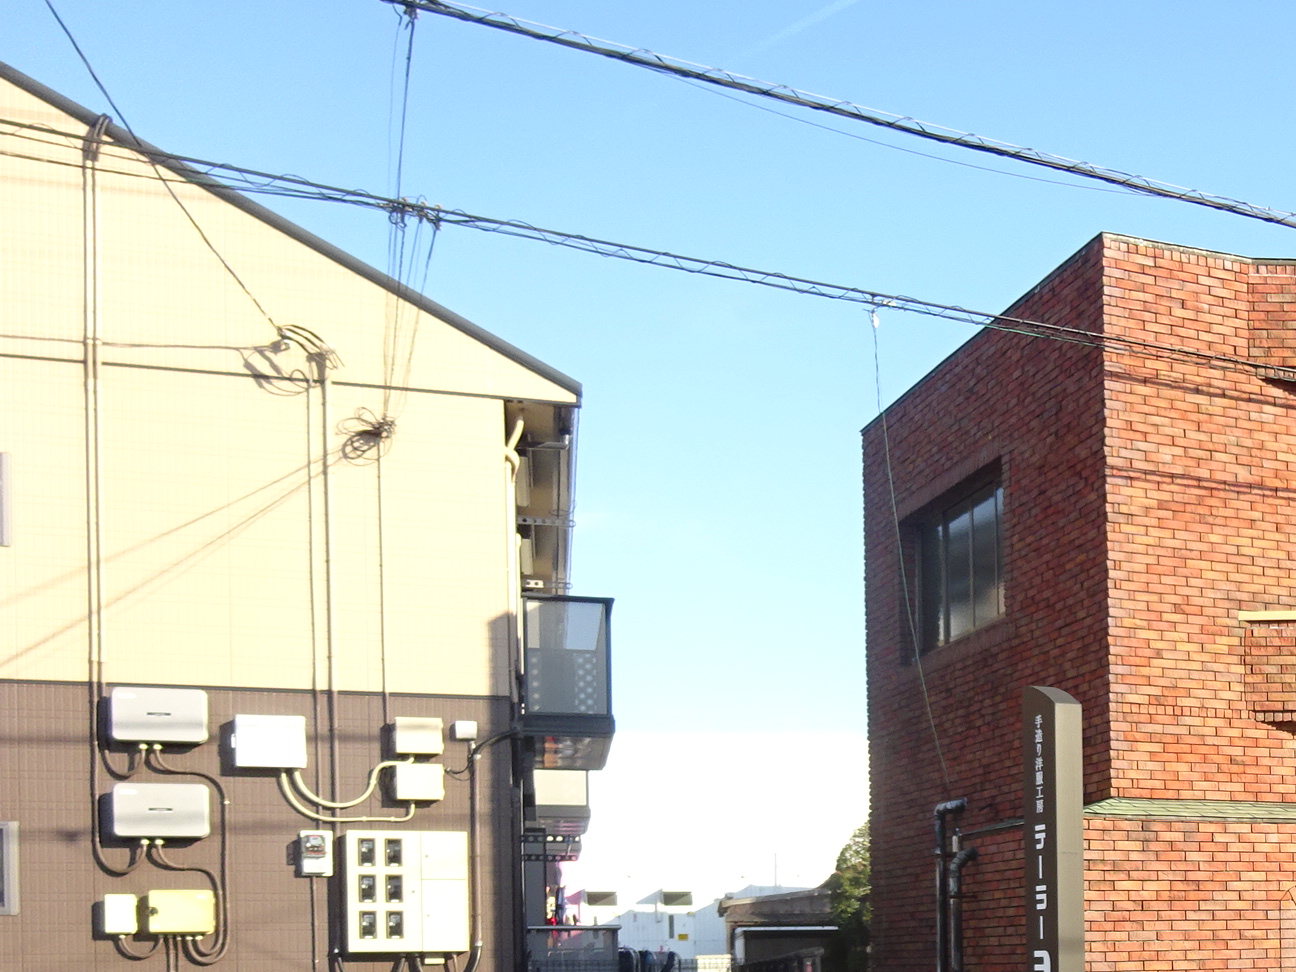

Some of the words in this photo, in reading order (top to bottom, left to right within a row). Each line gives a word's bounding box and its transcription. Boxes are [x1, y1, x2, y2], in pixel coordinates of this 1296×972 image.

[1034, 714, 1045, 813] 手造り洋服工房
